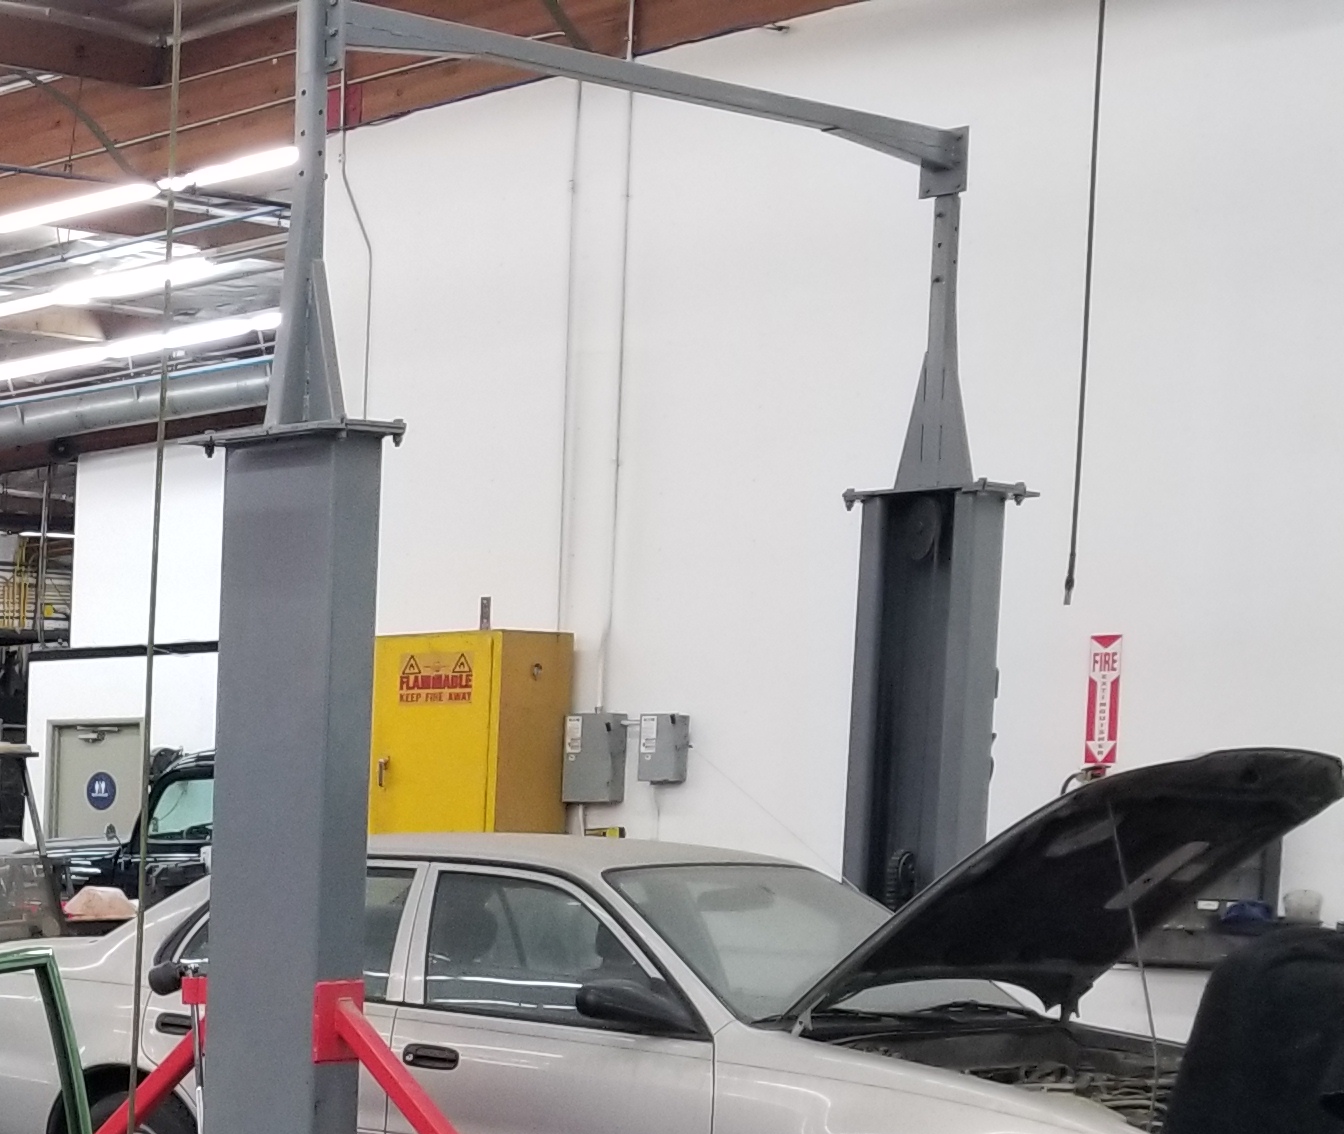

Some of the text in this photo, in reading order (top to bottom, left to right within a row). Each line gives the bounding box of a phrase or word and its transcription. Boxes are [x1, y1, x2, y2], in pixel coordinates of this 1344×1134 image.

[1092, 652, 1118, 673] FIRE
[399, 674, 473, 691] FLAMMABLE
[399, 692, 472, 703] KEEP FIRE AWAY
